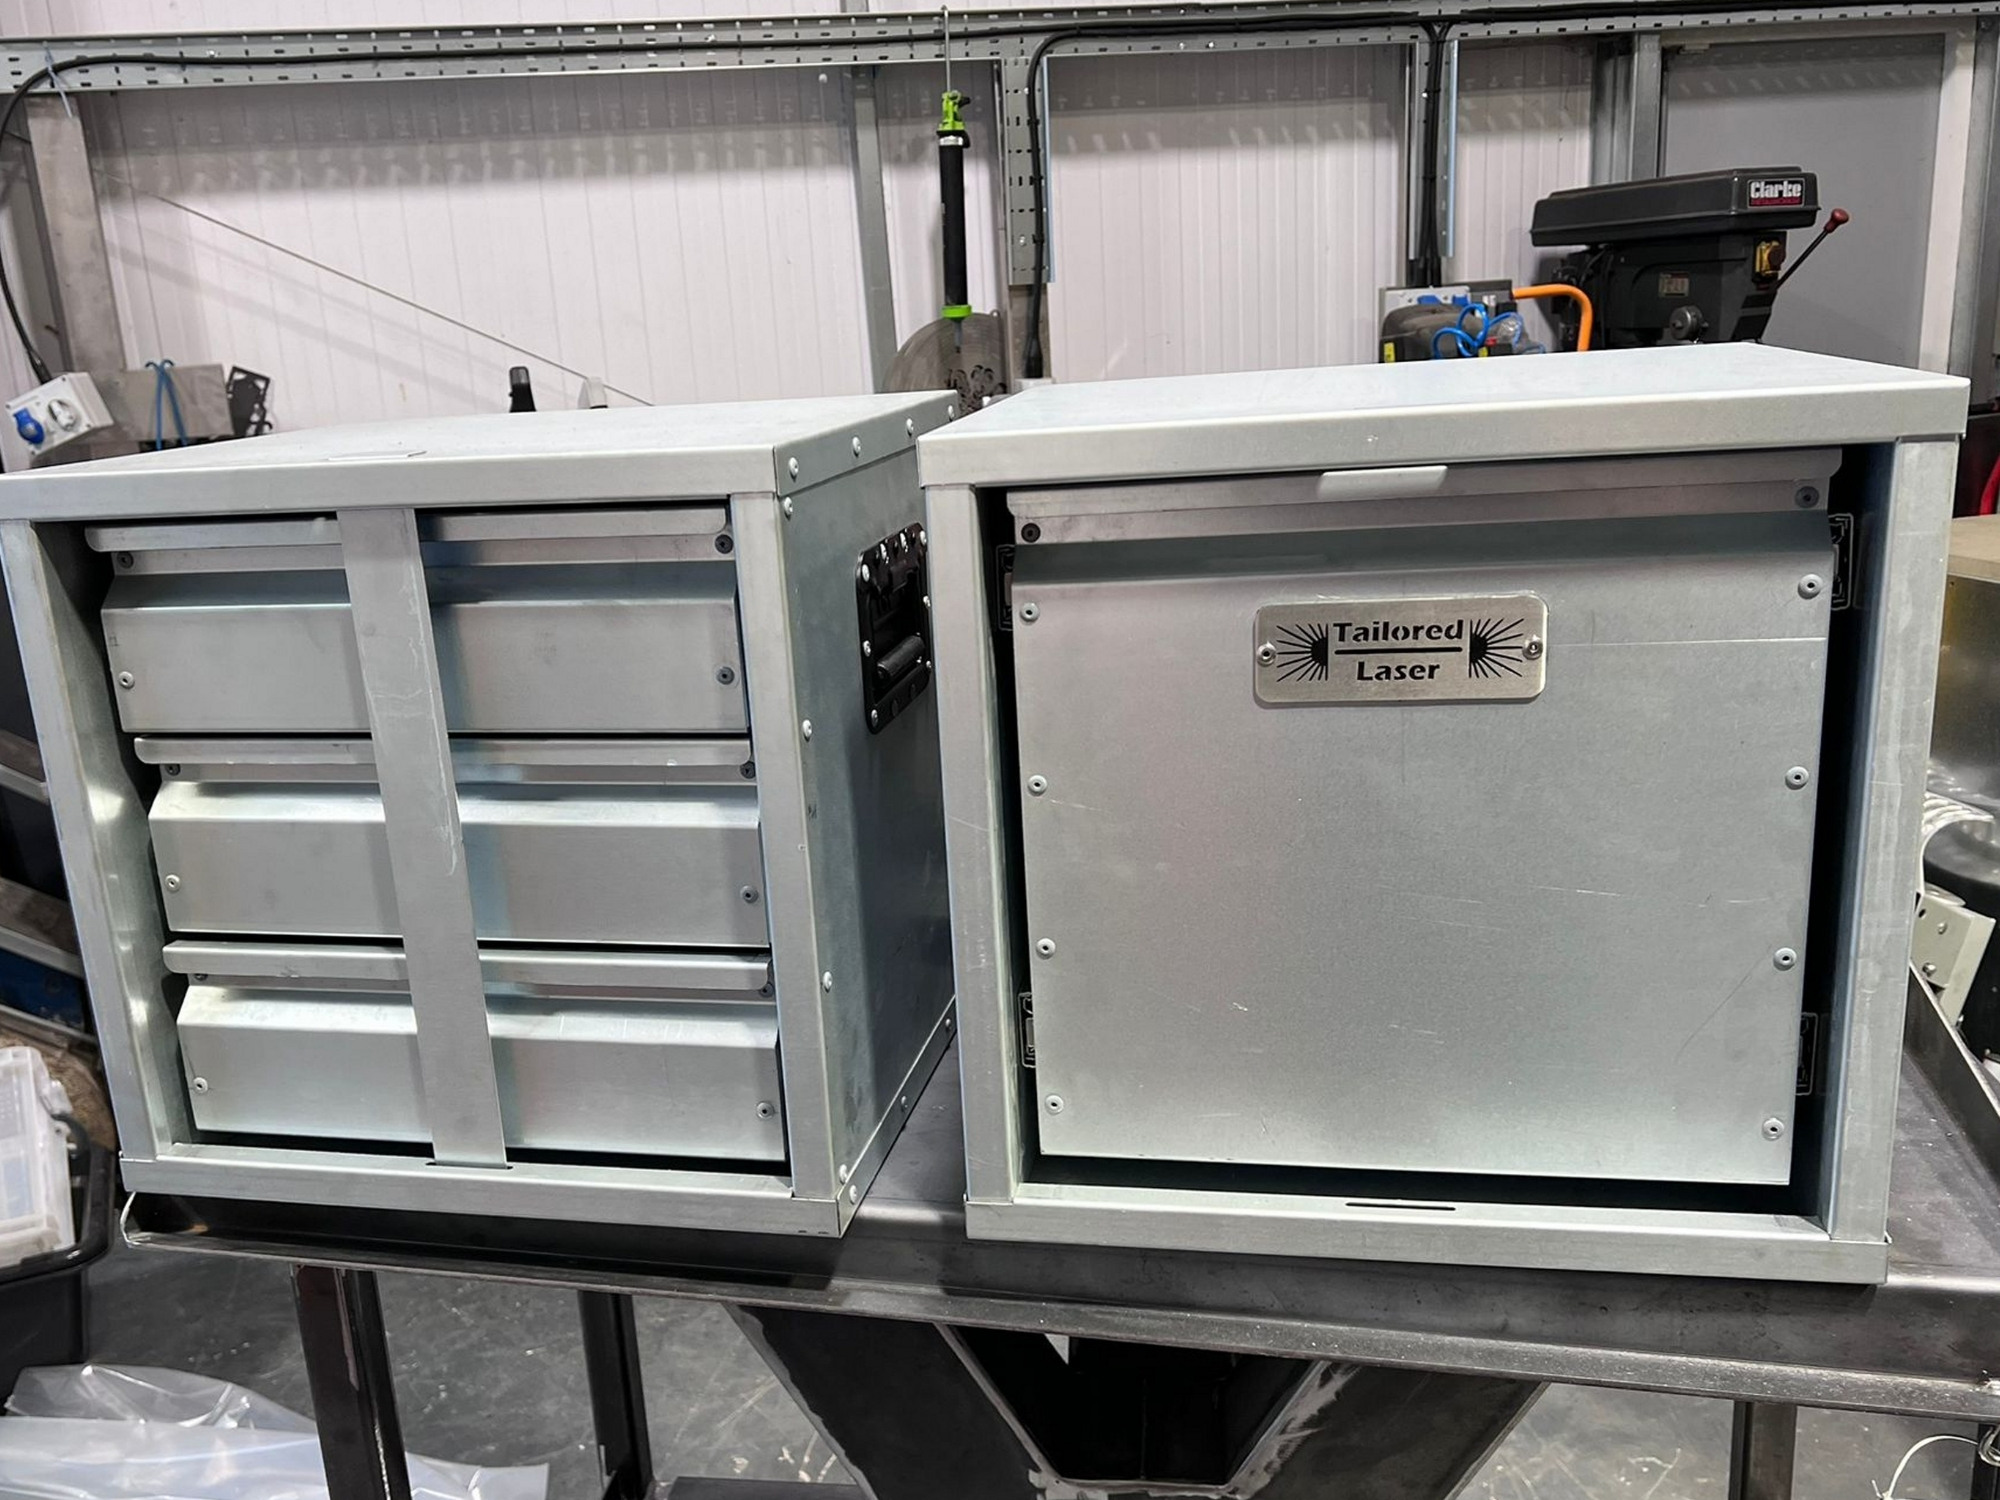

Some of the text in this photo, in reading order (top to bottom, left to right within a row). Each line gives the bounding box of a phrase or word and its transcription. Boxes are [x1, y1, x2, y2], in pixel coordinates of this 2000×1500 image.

[1750, 181, 1802, 198] Clarke
[1333, 619, 1464, 643] Tailored
[1356, 661, 1440, 681] Laser
